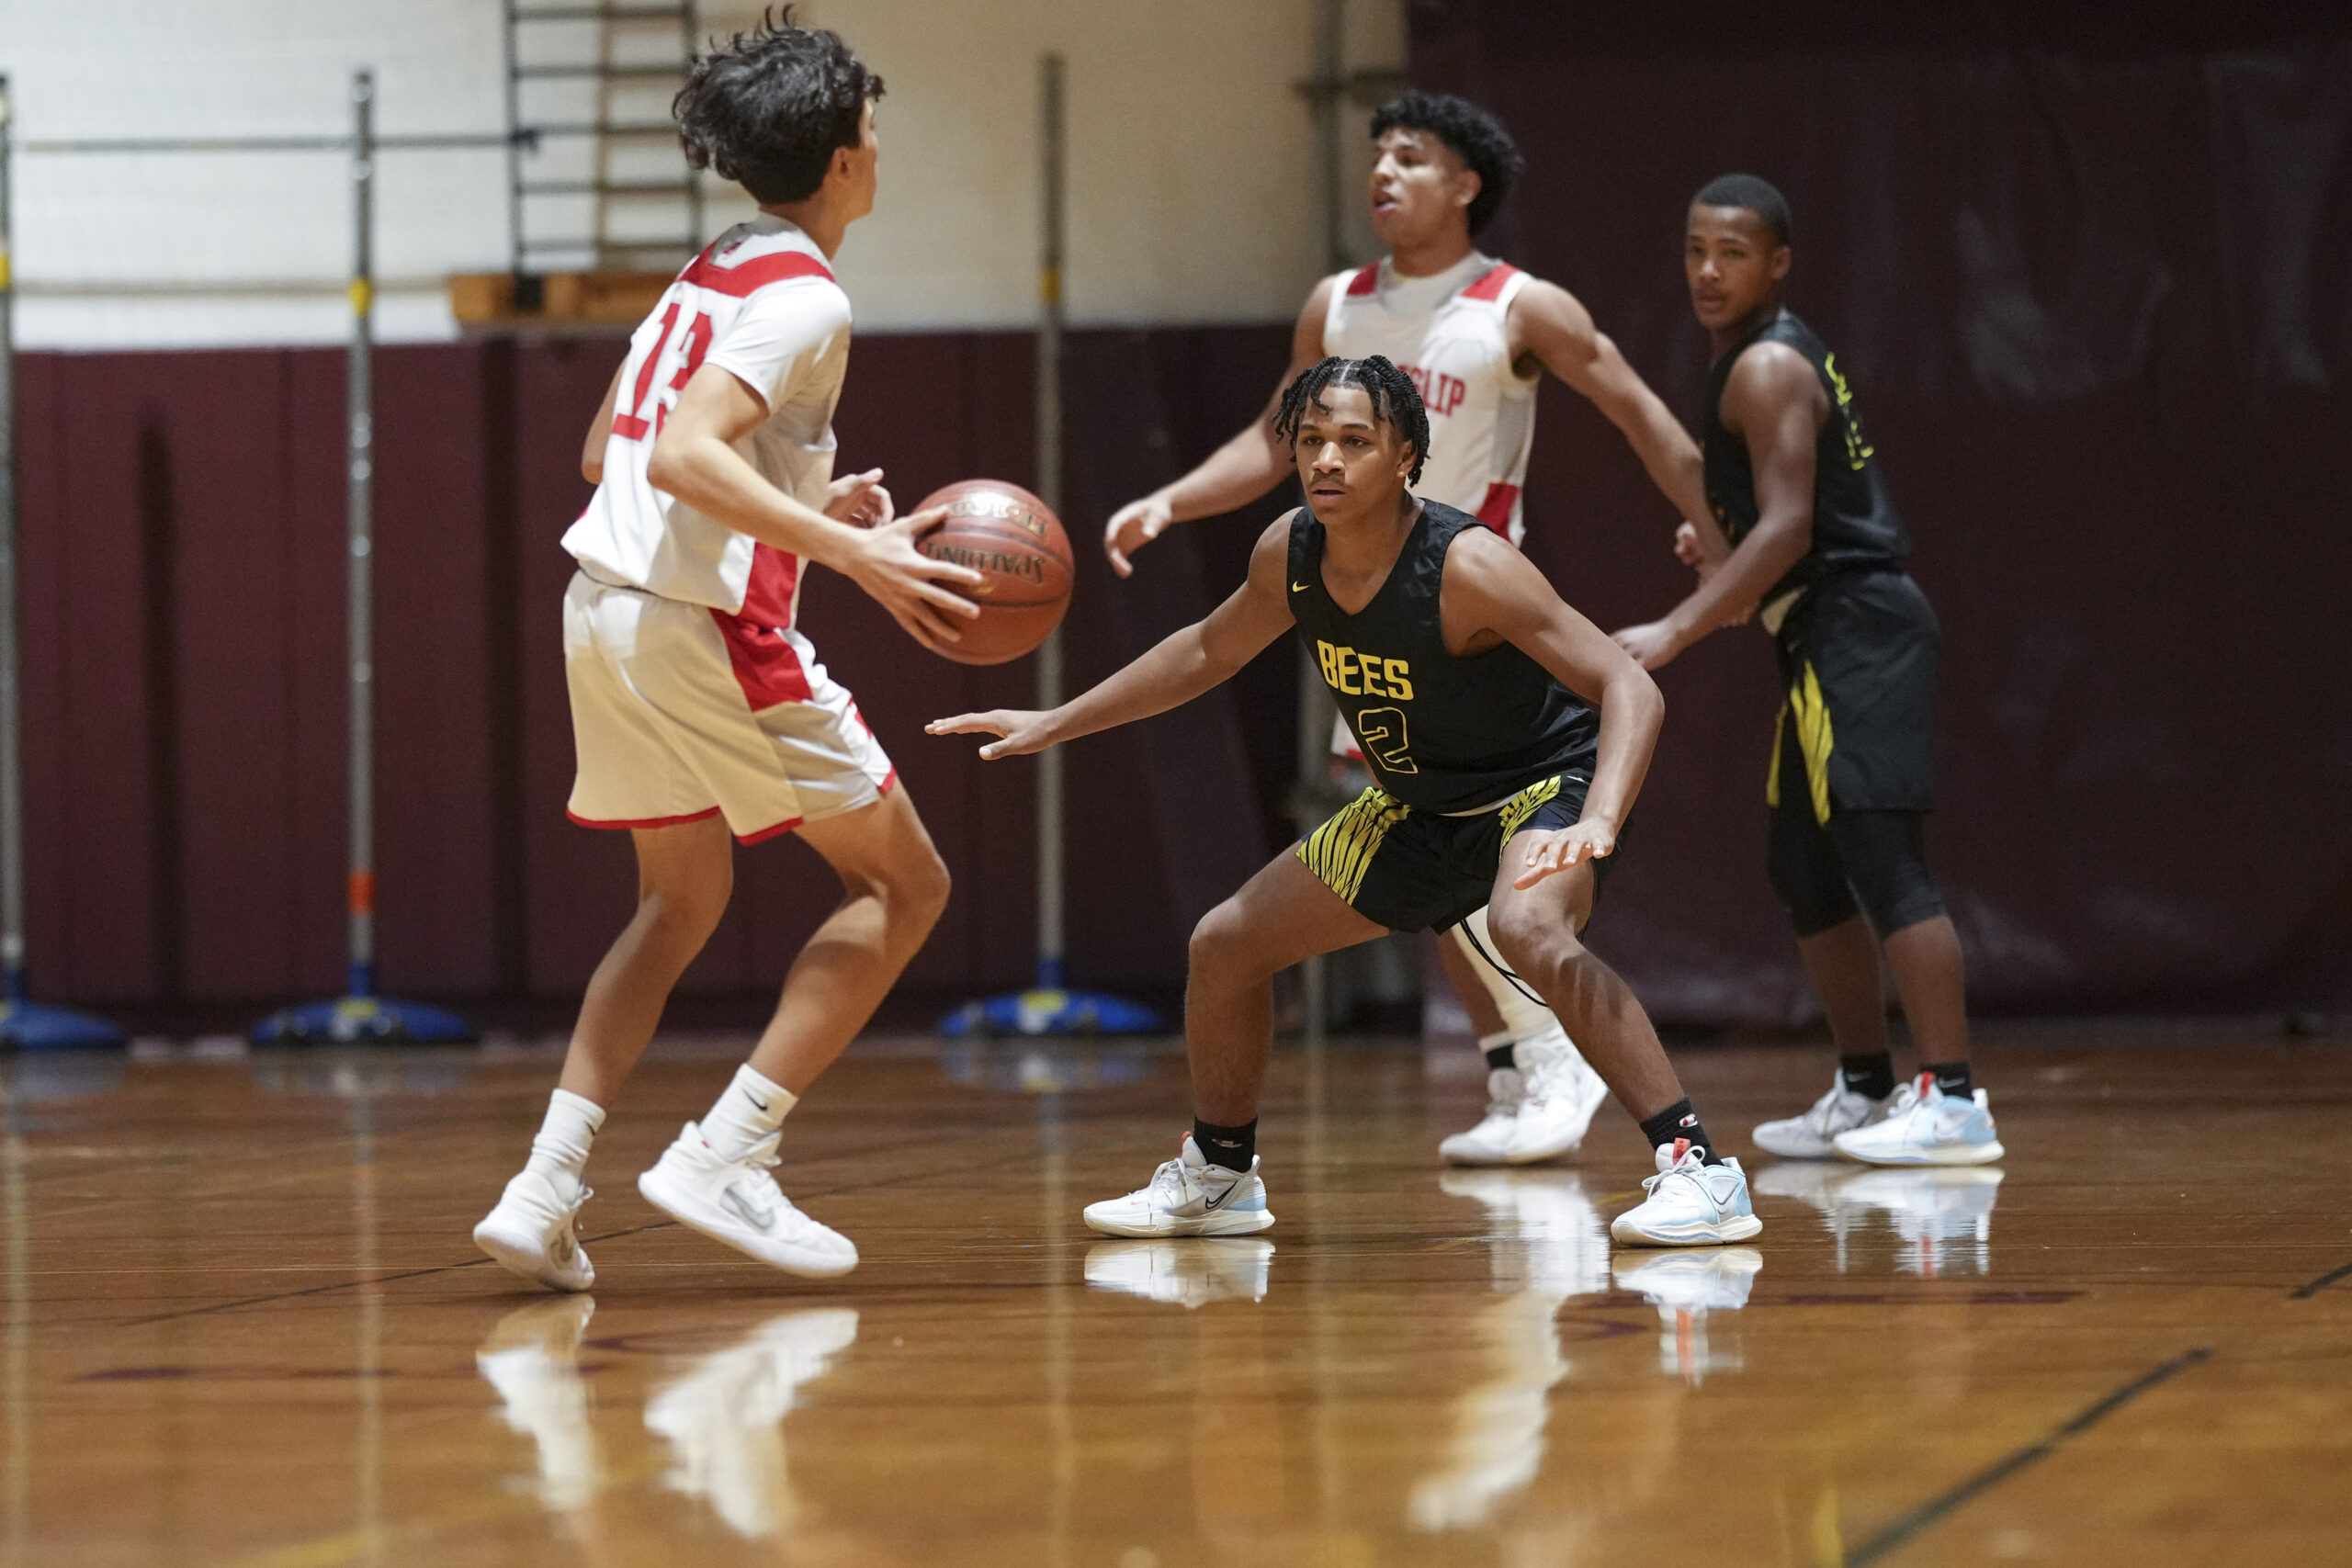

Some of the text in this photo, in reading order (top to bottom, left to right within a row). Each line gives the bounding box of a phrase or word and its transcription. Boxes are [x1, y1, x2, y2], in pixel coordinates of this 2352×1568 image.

[1397, 365, 1466, 416] SLIP
[1317, 639, 1414, 701] BEES
[1358, 706, 1419, 774] 2
